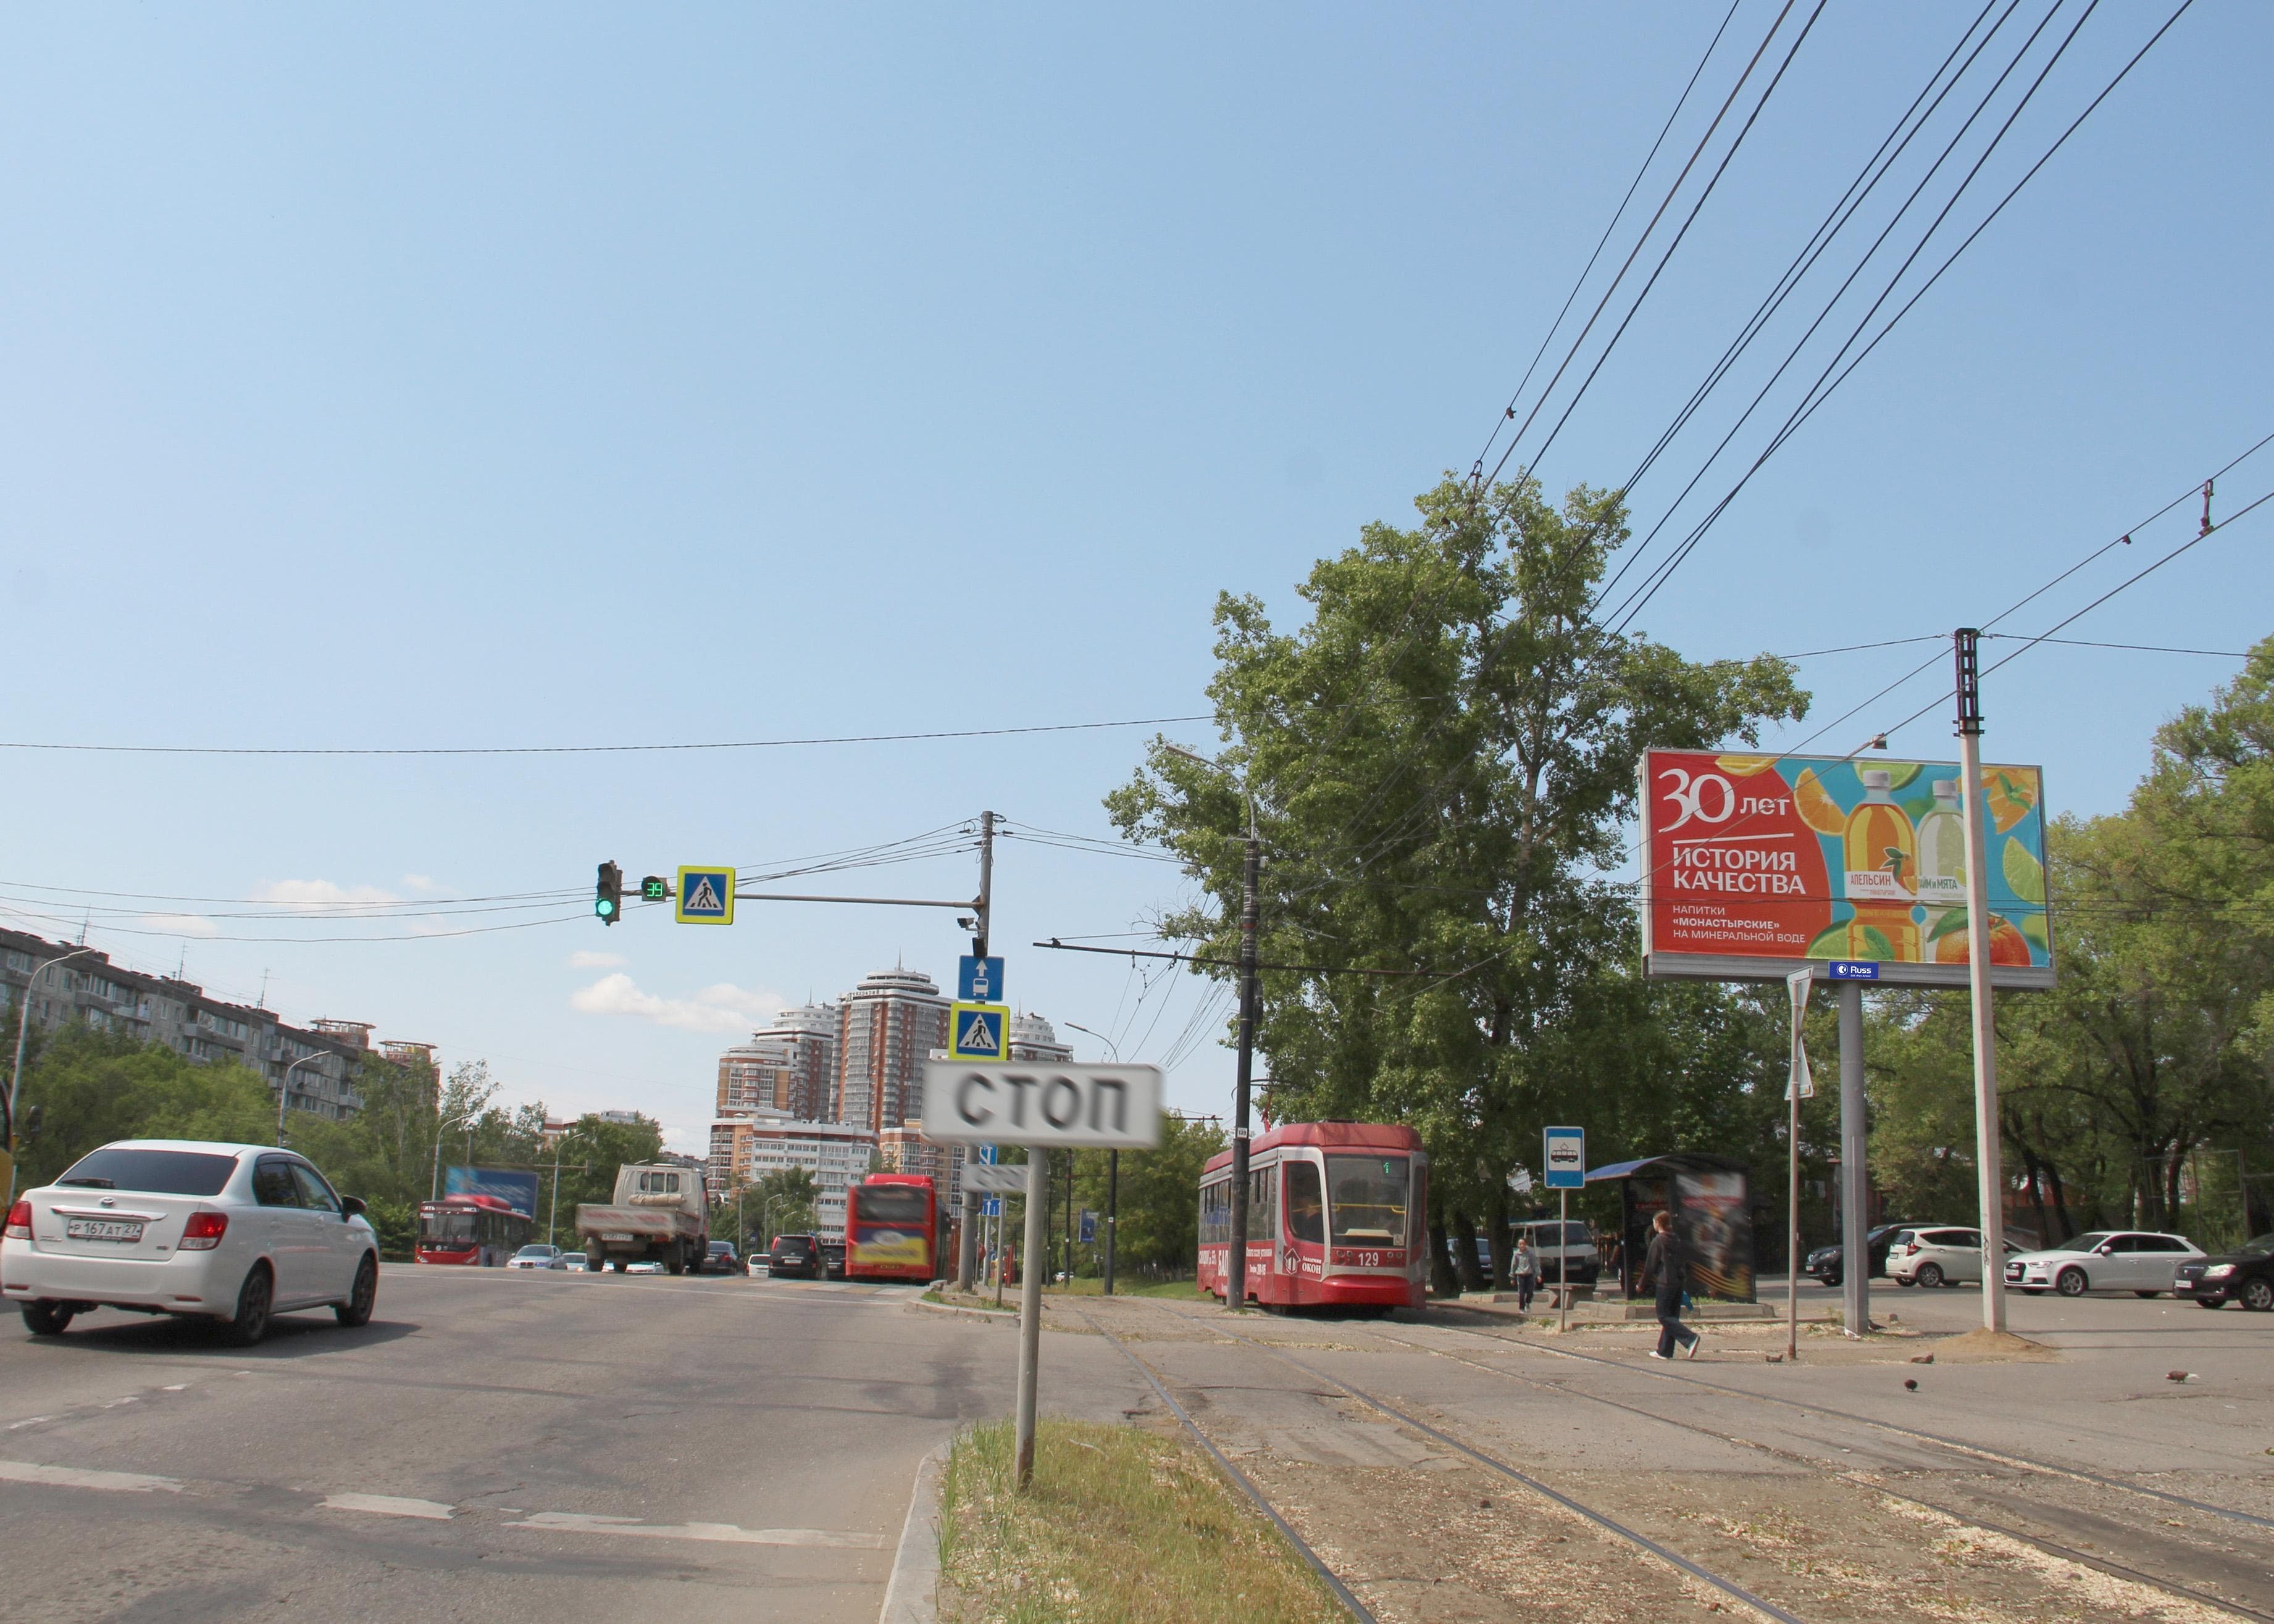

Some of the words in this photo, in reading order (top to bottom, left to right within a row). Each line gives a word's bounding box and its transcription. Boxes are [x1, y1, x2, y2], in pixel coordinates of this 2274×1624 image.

[1658, 768, 1736, 833] 30
[1740, 797, 1791, 816] лет
[1673, 847, 1796, 872] ИСТОРИЯ
[1673, 869, 1807, 894] КАЧЕСТВА
[1850, 874, 1891, 886] АПЕЛЬСИН
[1937, 878, 1957, 889] МЯТА
[646, 883, 663, 897] 39
[1673, 905, 1725, 915] НАПИТКИ
[1673, 917, 1779, 930] «МОНАСТЫРСКИЕ»
[1673, 929, 1689, 939] НА
[1691, 930, 1774, 942] МИНЕРАЛЬНОЙ
[1777, 933, 1806, 944] ВОДЕ
[1850, 966, 1871, 974] Russ
[956, 1072, 1129, 1134] СТОП
[1358, 1252, 1379, 1266] 129
[1302, 1262, 1321, 1275] ОКОН
